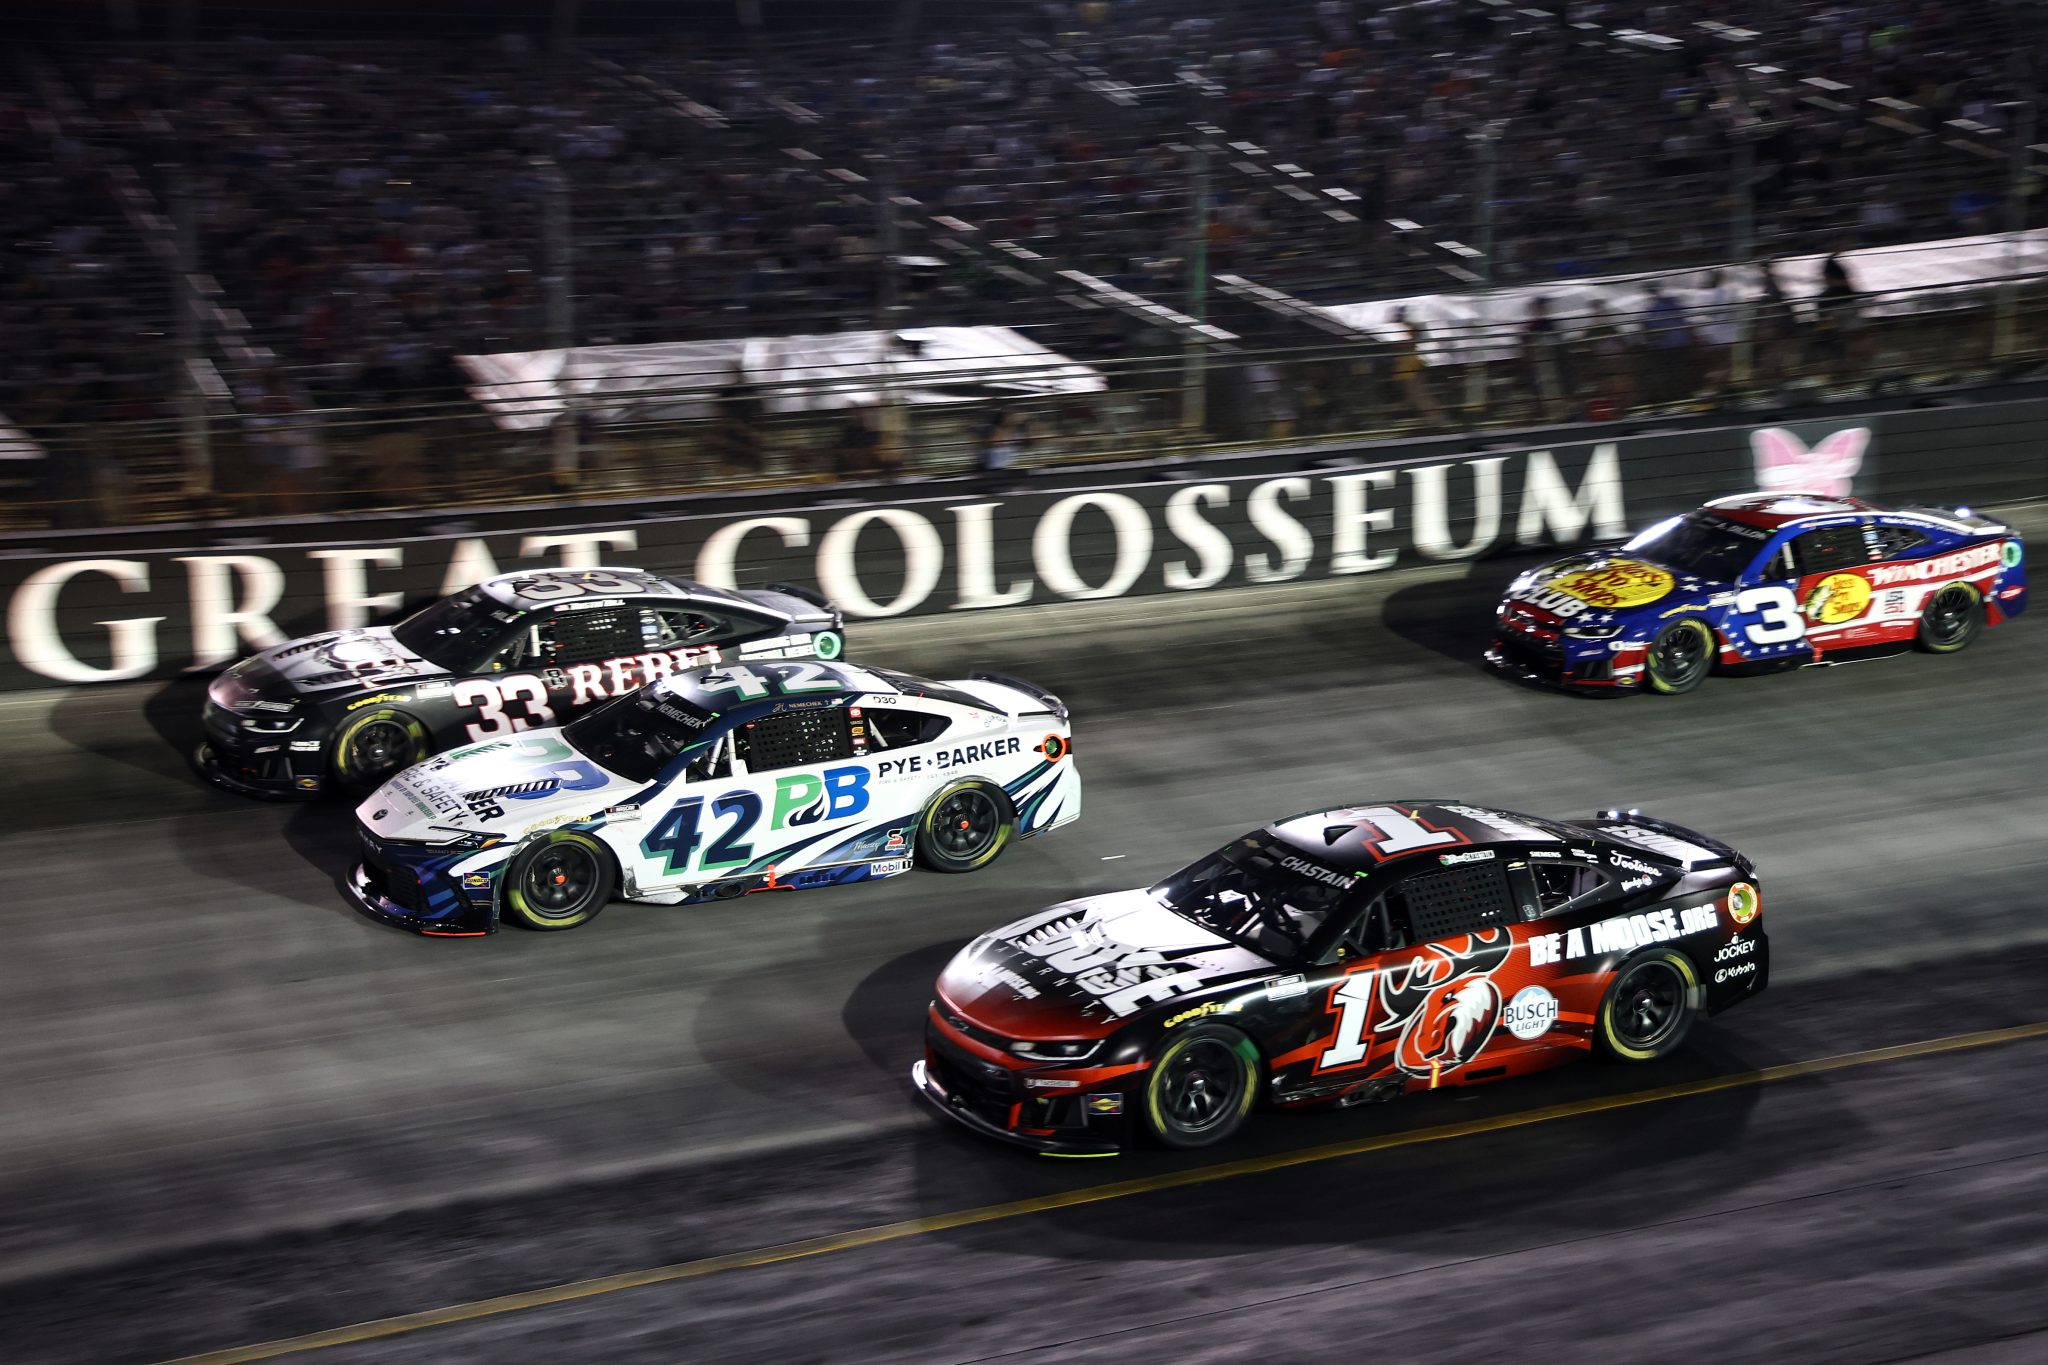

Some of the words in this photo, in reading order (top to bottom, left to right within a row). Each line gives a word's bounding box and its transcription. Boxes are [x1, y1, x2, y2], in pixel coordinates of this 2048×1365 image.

[695, 443, 1635, 617] COLOSSEUM
[1866, 542, 2003, 585] WINCHESTER
[1509, 585, 1591, 617] CLUB
[1736, 586, 1806, 645] 3
[698, 662, 844, 702] 42
[453, 674, 552, 743] 33
[656, 702, 703, 730] NEMECHEK
[788, 701, 823, 709] NEMECHEK
[878, 756, 922, 778] PYE
[936, 737, 1021, 770] BARKER
[421, 783, 470, 823] SAFETY
[772, 764, 871, 831] PB
[639, 790, 762, 876] 42
[464, 877, 490, 885] SUNOCO
[872, 861, 901, 874] Mobil
[1279, 856, 1357, 890] CHASTAIN
[1528, 933, 1561, 967] BE
[1566, 927, 1586, 960] A
[1590, 903, 1719, 955] MOOSE.ORG
[1713, 939, 1756, 963] JOCKEY
[1727, 961, 1756, 978] Kubota
[1314, 966, 1378, 1074] 1
[1505, 1000, 1558, 1025] BUSCH
[1515, 1019, 1547, 1032] LIGHT
